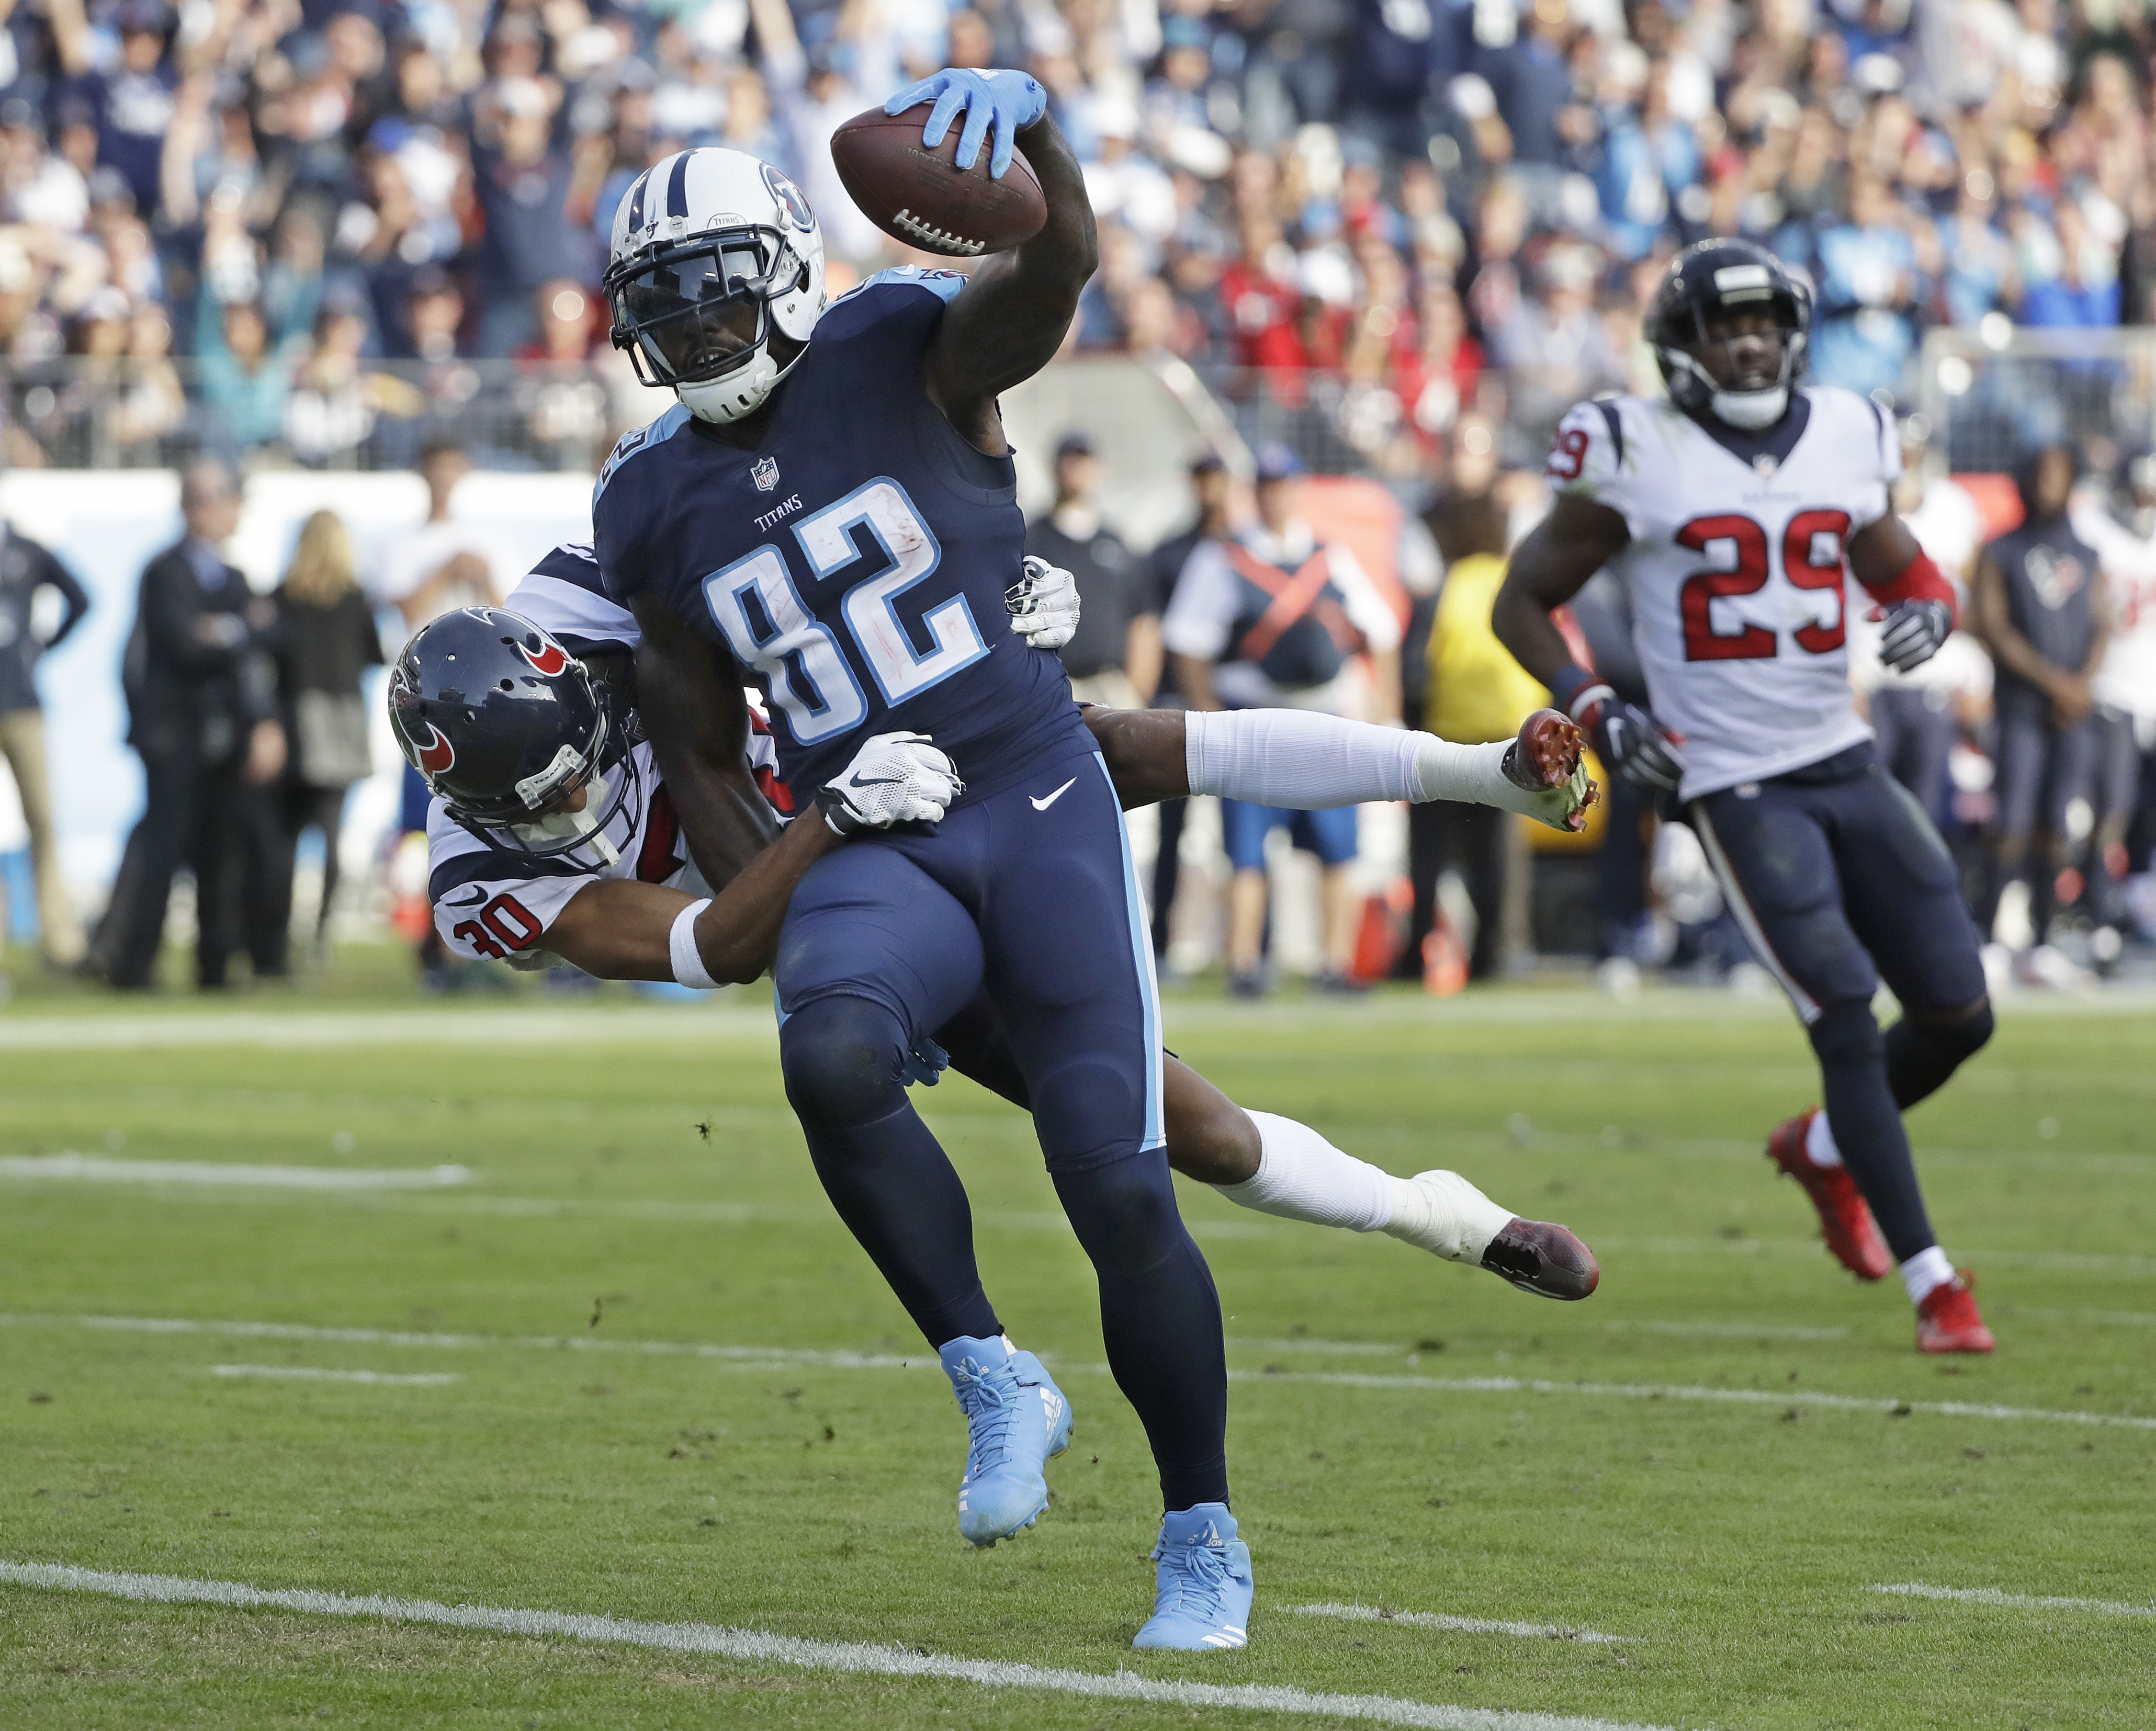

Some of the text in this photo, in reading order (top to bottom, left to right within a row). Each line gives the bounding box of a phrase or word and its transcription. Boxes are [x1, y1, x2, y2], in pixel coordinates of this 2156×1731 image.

[714, 216, 739, 225] TITANS
[759, 471, 776, 487] NFL
[753, 493, 803, 533] TITANS
[702, 476, 990, 746] 82
[1676, 509, 1852, 663] 29
[453, 893, 543, 959] 30
